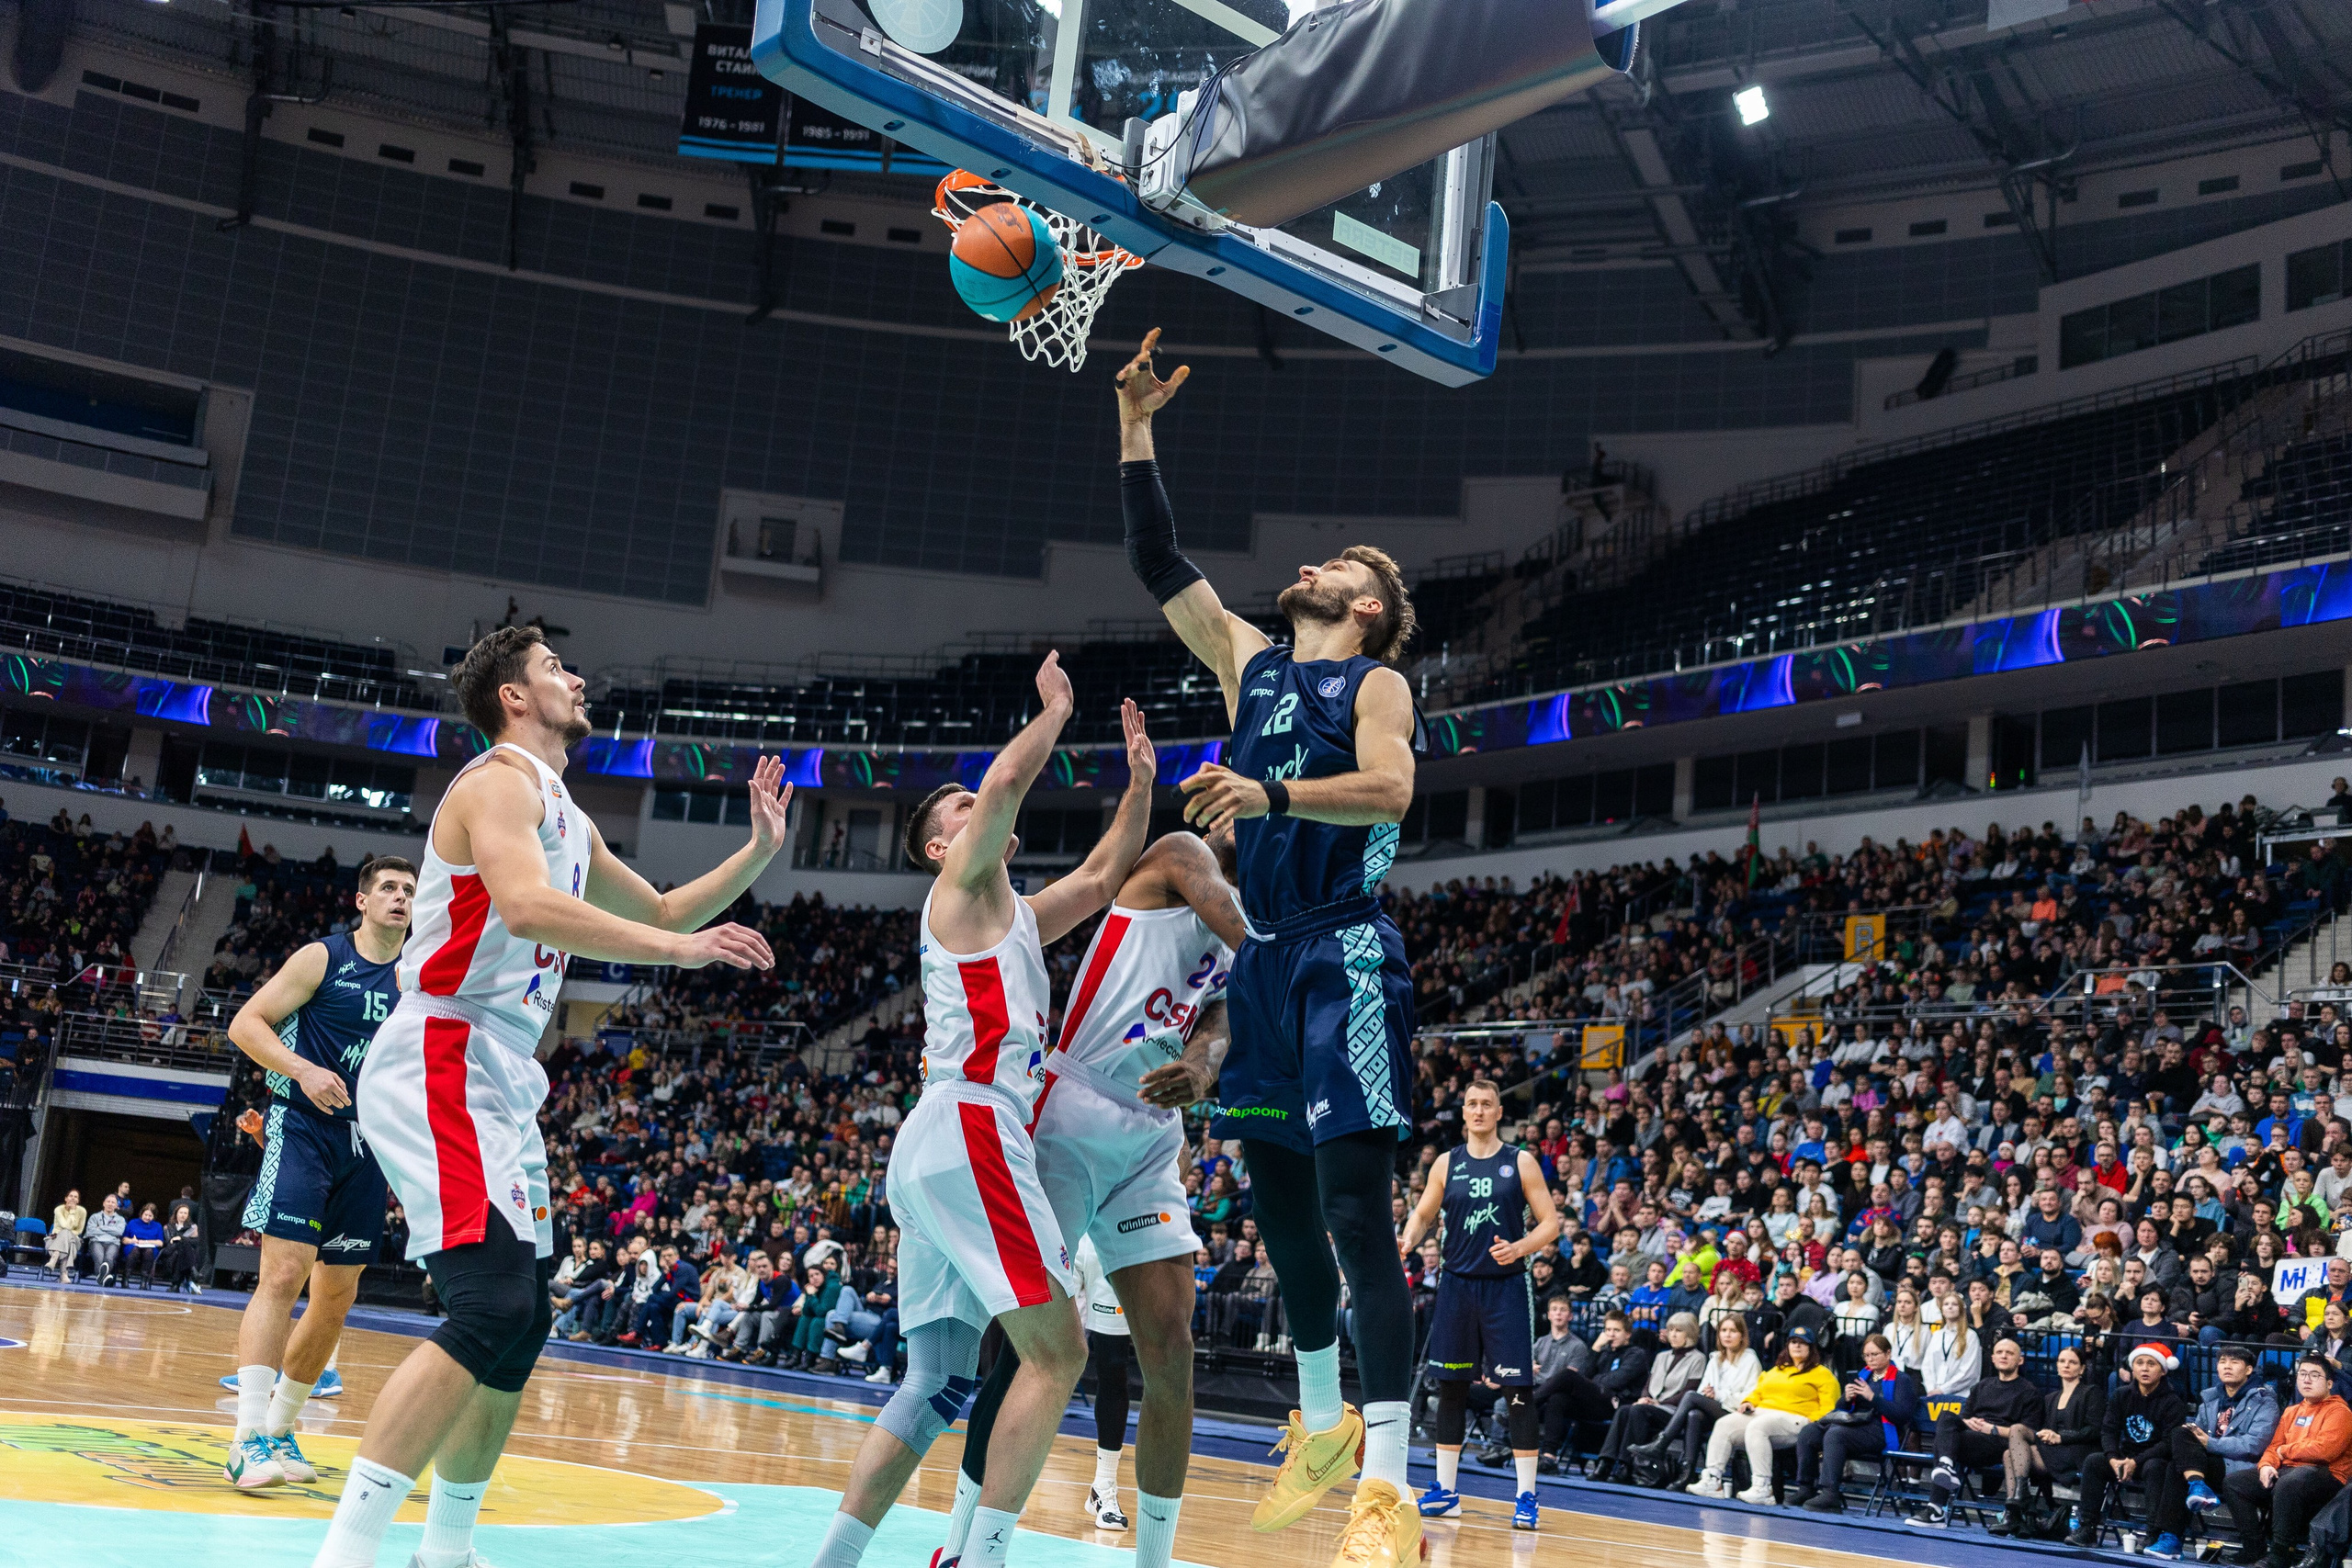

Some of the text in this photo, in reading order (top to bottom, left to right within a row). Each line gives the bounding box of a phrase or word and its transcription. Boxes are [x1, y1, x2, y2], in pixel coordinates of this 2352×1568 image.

[710, 85, 763, 100] ТРЕНЕР
[607, 962, 625, 977] C
[334, 979, 361, 990] Kempa
[363, 990, 389, 1022] 15
[1468, 1177, 1493, 1199] 38
[277, 1212, 306, 1224] Kempa
[1120, 1215, 1157, 1233] Winline
[360, 1491, 368, 1500] 8
[988, 1545, 995, 1553] 7
